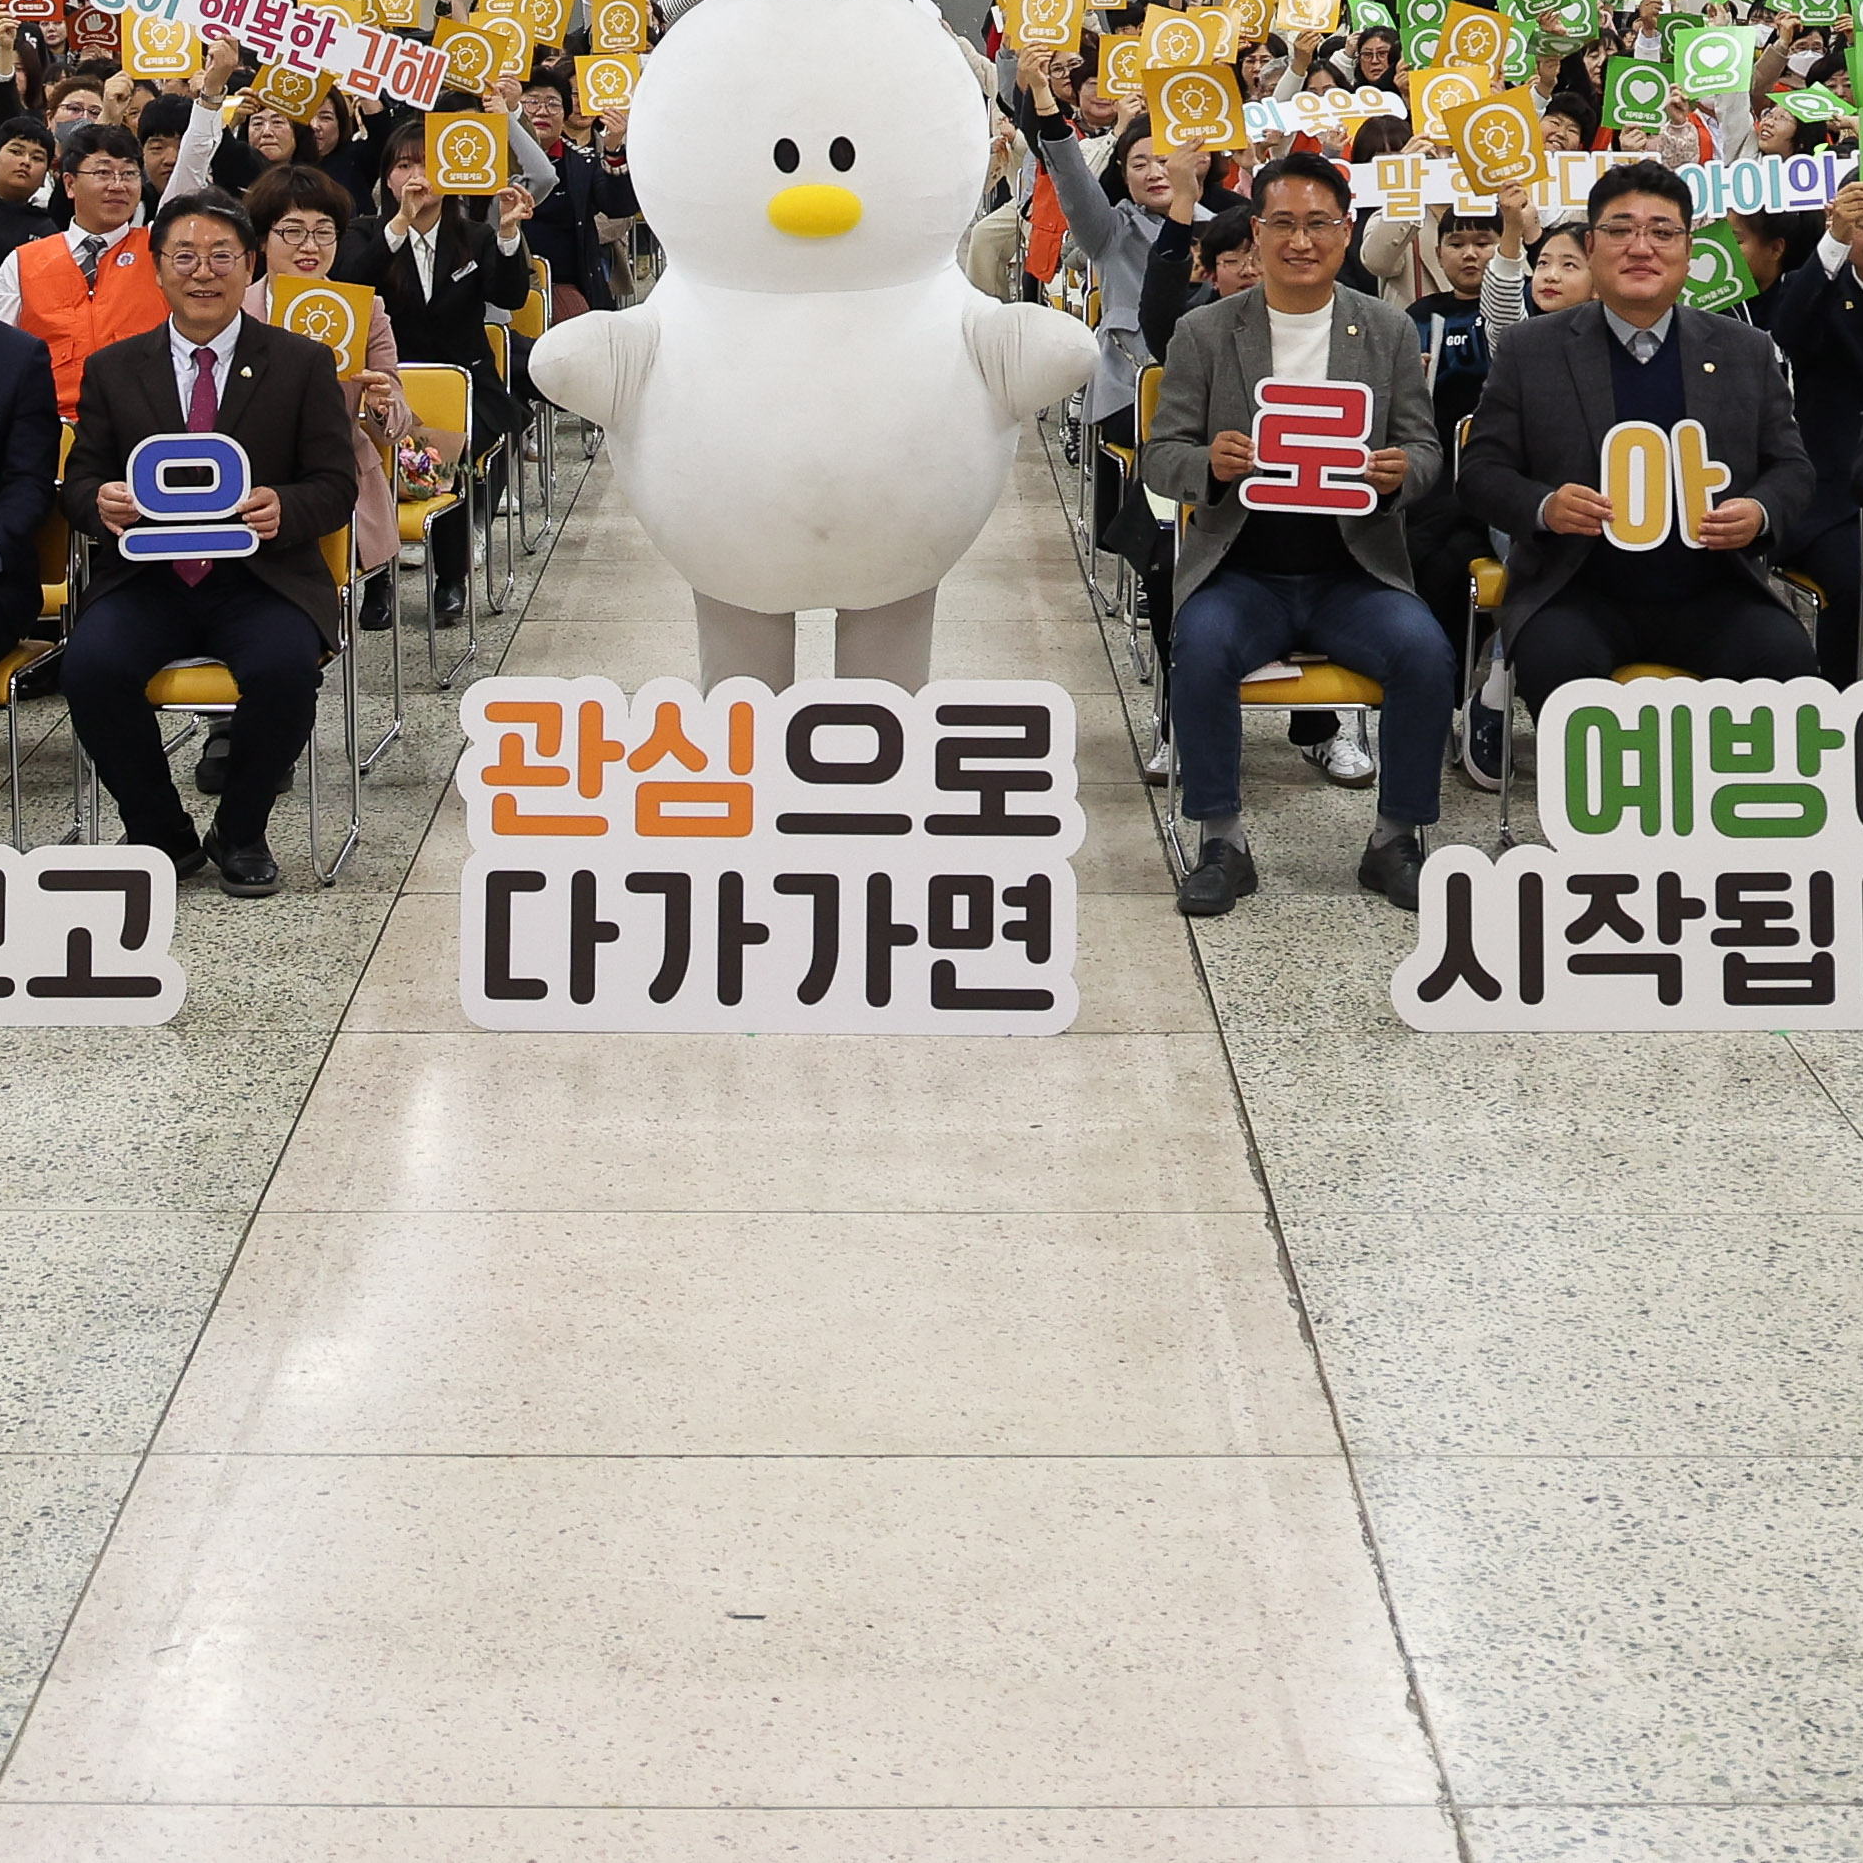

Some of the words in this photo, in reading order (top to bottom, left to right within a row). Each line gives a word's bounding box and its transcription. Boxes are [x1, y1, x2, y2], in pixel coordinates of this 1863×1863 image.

[347, 27, 447, 106] 김해
[1378, 155, 1430, 220] 말
[122, 436, 257, 558] 으
[1242, 380, 1376, 514] 로
[1604, 423, 1731, 549] 아
[481, 700, 1061, 837] 관심으로
[484, 869, 1055, 1011] 다가가면
